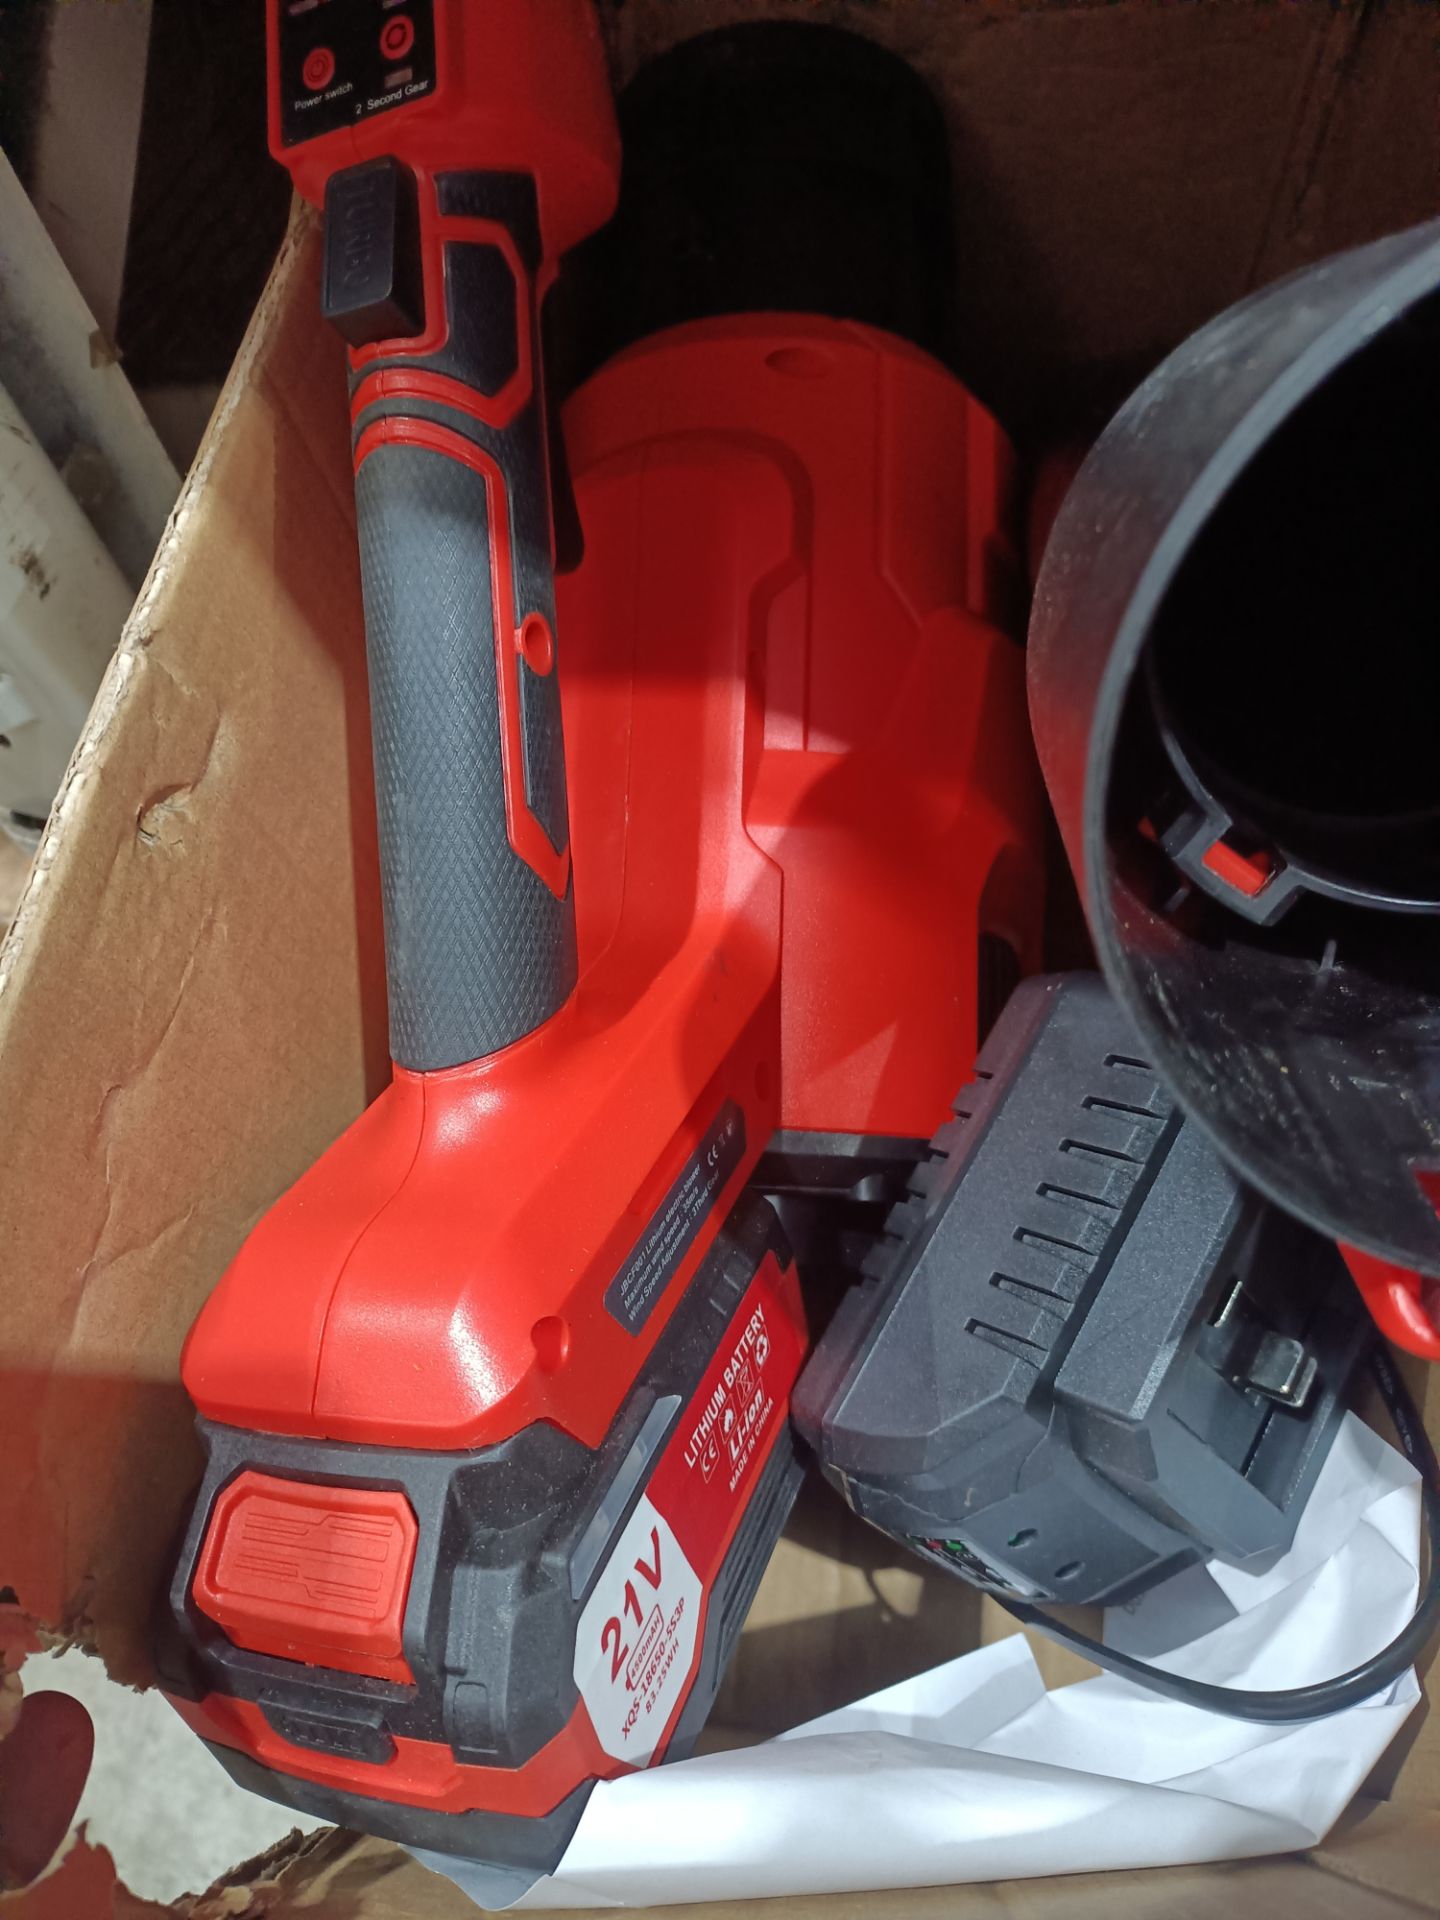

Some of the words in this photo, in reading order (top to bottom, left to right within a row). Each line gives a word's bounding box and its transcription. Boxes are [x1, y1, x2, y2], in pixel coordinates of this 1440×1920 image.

[294, 95, 322, 111] Power
[324, 81, 353, 101] switch
[355, 103, 363, 115] 2
[366, 88, 402, 110] Second
[404, 79, 429, 96] Gear
[620, 1251, 647, 1296] JBCF001
[645, 1220, 666, 1255] Lithium
[665, 1190, 685, 1223] electric
[683, 1163, 700, 1193] blower
[624, 1262, 652, 1310] Maximum
[651, 1240, 665, 1266] wind
[663, 1214, 681, 1246] speed
[628, 1293, 645, 1321] Wind
[643, 1263, 663, 1298] Speed
[661, 1218, 690, 1269] Adjustment
[683, 1382, 727, 1470] LITHIUM
[723, 1301, 765, 1390] BATTERY
[729, 1388, 763, 1462] Li-ion
[729, 1449, 749, 1493] MADE
[747, 1433, 756, 1453] IN
[754, 1396, 774, 1437] CHINA
[600, 1525, 663, 1686] 21V
[631, 1614, 661, 1680] 4500mAH
